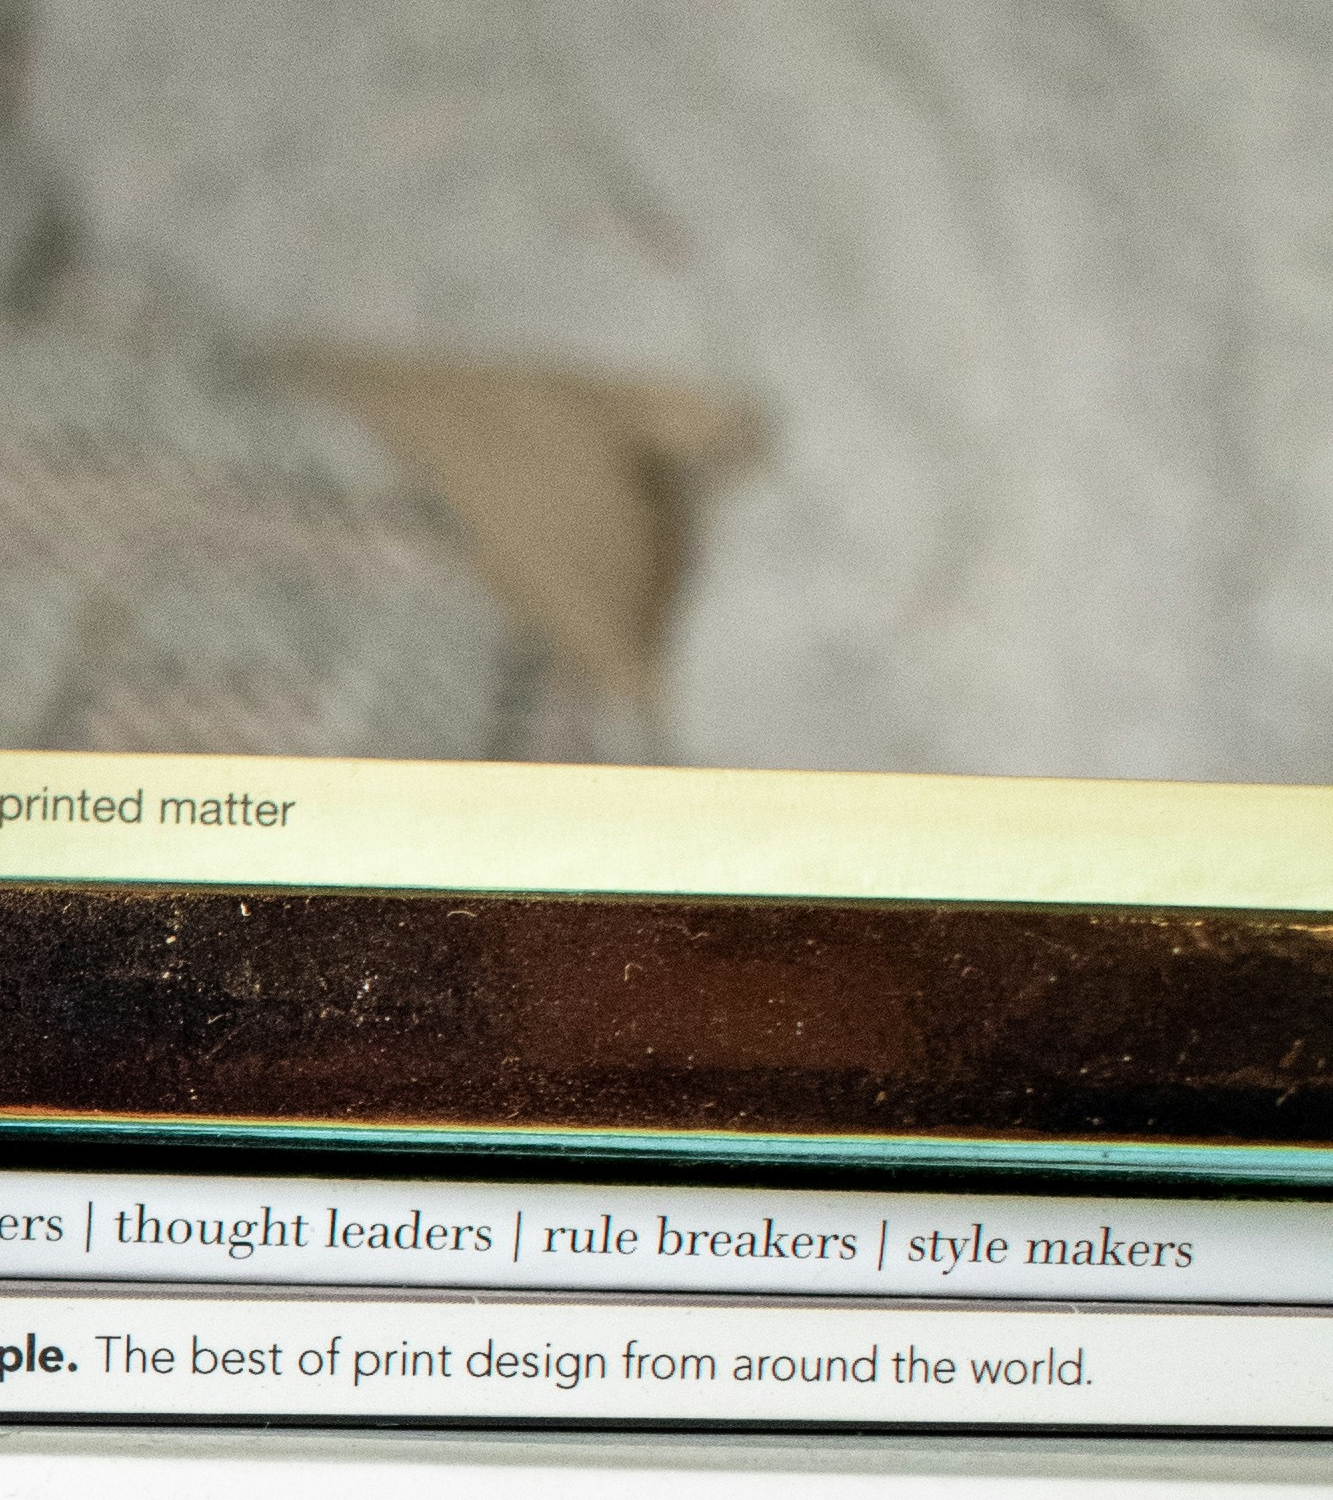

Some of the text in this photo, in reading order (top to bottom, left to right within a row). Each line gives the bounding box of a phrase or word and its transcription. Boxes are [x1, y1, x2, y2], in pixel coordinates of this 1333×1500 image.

[158, 792, 297, 829] matter
[115, 1202, 307, 1259] thought
[326, 1207, 494, 1251] leaders
[544, 1213, 640, 1255] rule
[656, 1214, 858, 1260] breakers
[907, 1222, 1010, 1276] style
[1025, 1225, 1195, 1268] makers
[94, 1333, 177, 1375] The
[190, 1334, 284, 1377] best
[296, 1334, 343, 1377] of
[352, 1339, 453, 1388] print
[464, 1337, 608, 1391] design
[621, 1338, 718, 1381] from
[731, 1343, 880, 1384] around
[891, 1344, 958, 1385] the
[969, 1346, 1093, 1387] world.
